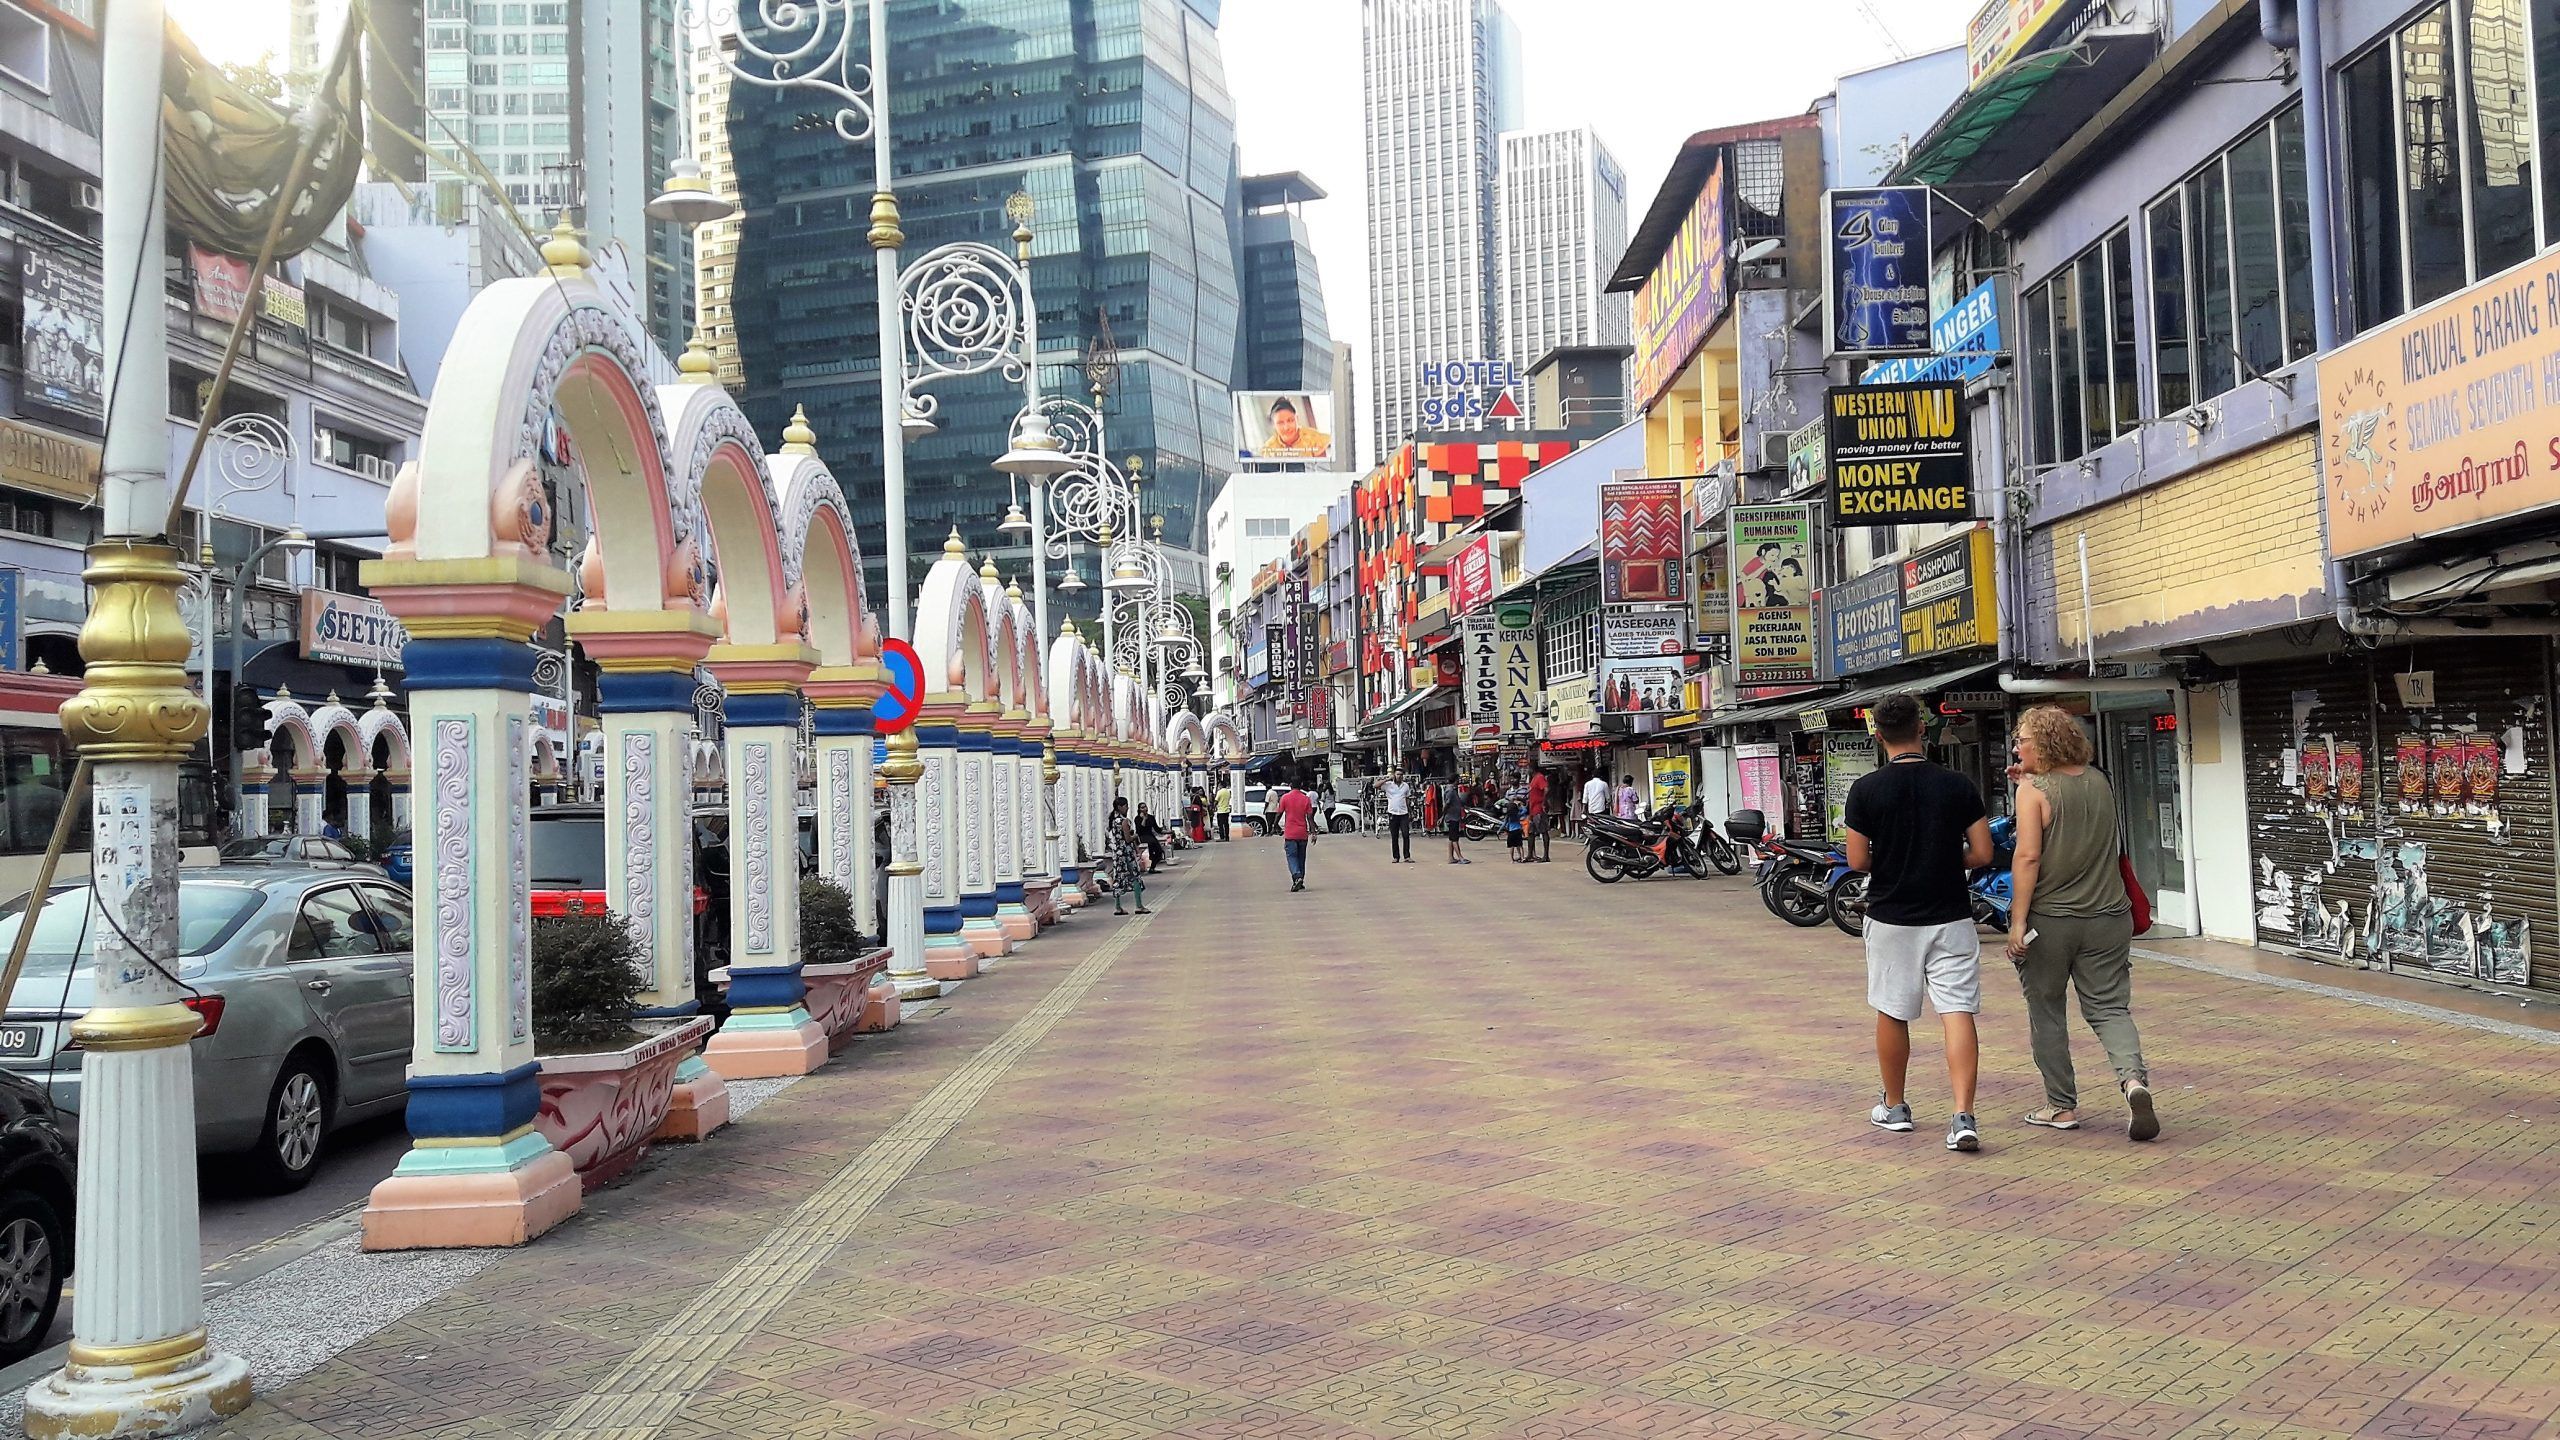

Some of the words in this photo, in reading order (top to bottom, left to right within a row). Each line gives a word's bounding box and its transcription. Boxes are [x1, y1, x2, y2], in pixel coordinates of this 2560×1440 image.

[2401, 313, 2466, 385] MENJUAL
[2473, 280, 2538, 358] BARANG
[2547, 271, 2560, 328] R
[1422, 361, 1522, 385] HOTEL
[1423, 391, 1482, 425] gds
[1834, 390, 1906, 417] WESTERN
[2406, 389, 2461, 452] SELMAG
[2466, 362, 2535, 432] SEVENTH
[1857, 416, 1907, 440] UNION
[1837, 444, 1875, 456] moving
[1877, 443, 1911, 455] money
[1914, 441, 1928, 451] for
[1930, 440, 1961, 450] better
[1838, 463, 1921, 488] MONEY
[1839, 487, 1966, 515] EXCHANGE
[1735, 512, 1763, 523] AGENSI
[1764, 510, 1806, 521] PEMBANTU
[1744, 526, 1773, 536] RUMAH
[1774, 524, 1798, 535] ASING
[1906, 567, 1917, 586] NS
[1917, 550, 1961, 581] CASHPOINT
[370, 605, 388, 616] RES
[1285, 583, 1293, 625] PARK
[1758, 611, 1791, 620] AGENSI
[1934, 596, 1961, 624] MONEY
[1607, 618, 1676, 629] VASEEGARA
[1749, 623, 1801, 632] PEKERJAAN
[1844, 599, 1895, 639] FOTOSTAT
[1745, 636, 1767, 645] JASA
[1770, 634, 1807, 644] TENAGA
[1936, 619, 1976, 650] EXCHANGE
[320, 653, 341, 661] SOUTH
[349, 657, 369, 665] NORTH
[371, 660, 391, 668] INDIAN
[1304, 626, 1315, 675] INDIAN
[1755, 648, 1774, 656] SDN
[1778, 647, 1797, 655] BHD
[1287, 649, 1296, 701] HOTEL
[1474, 633, 1498, 712] TAILORS
[1745, 672, 1782, 680] 03-2272
[1786, 671, 1806, 679] 3155
[1507, 644, 1533, 731] ANAR
[1313, 687, 1325, 726] VIDEO
[1828, 739, 1874, 752] QueenZ
[0, 1030, 26, 1049] 09
